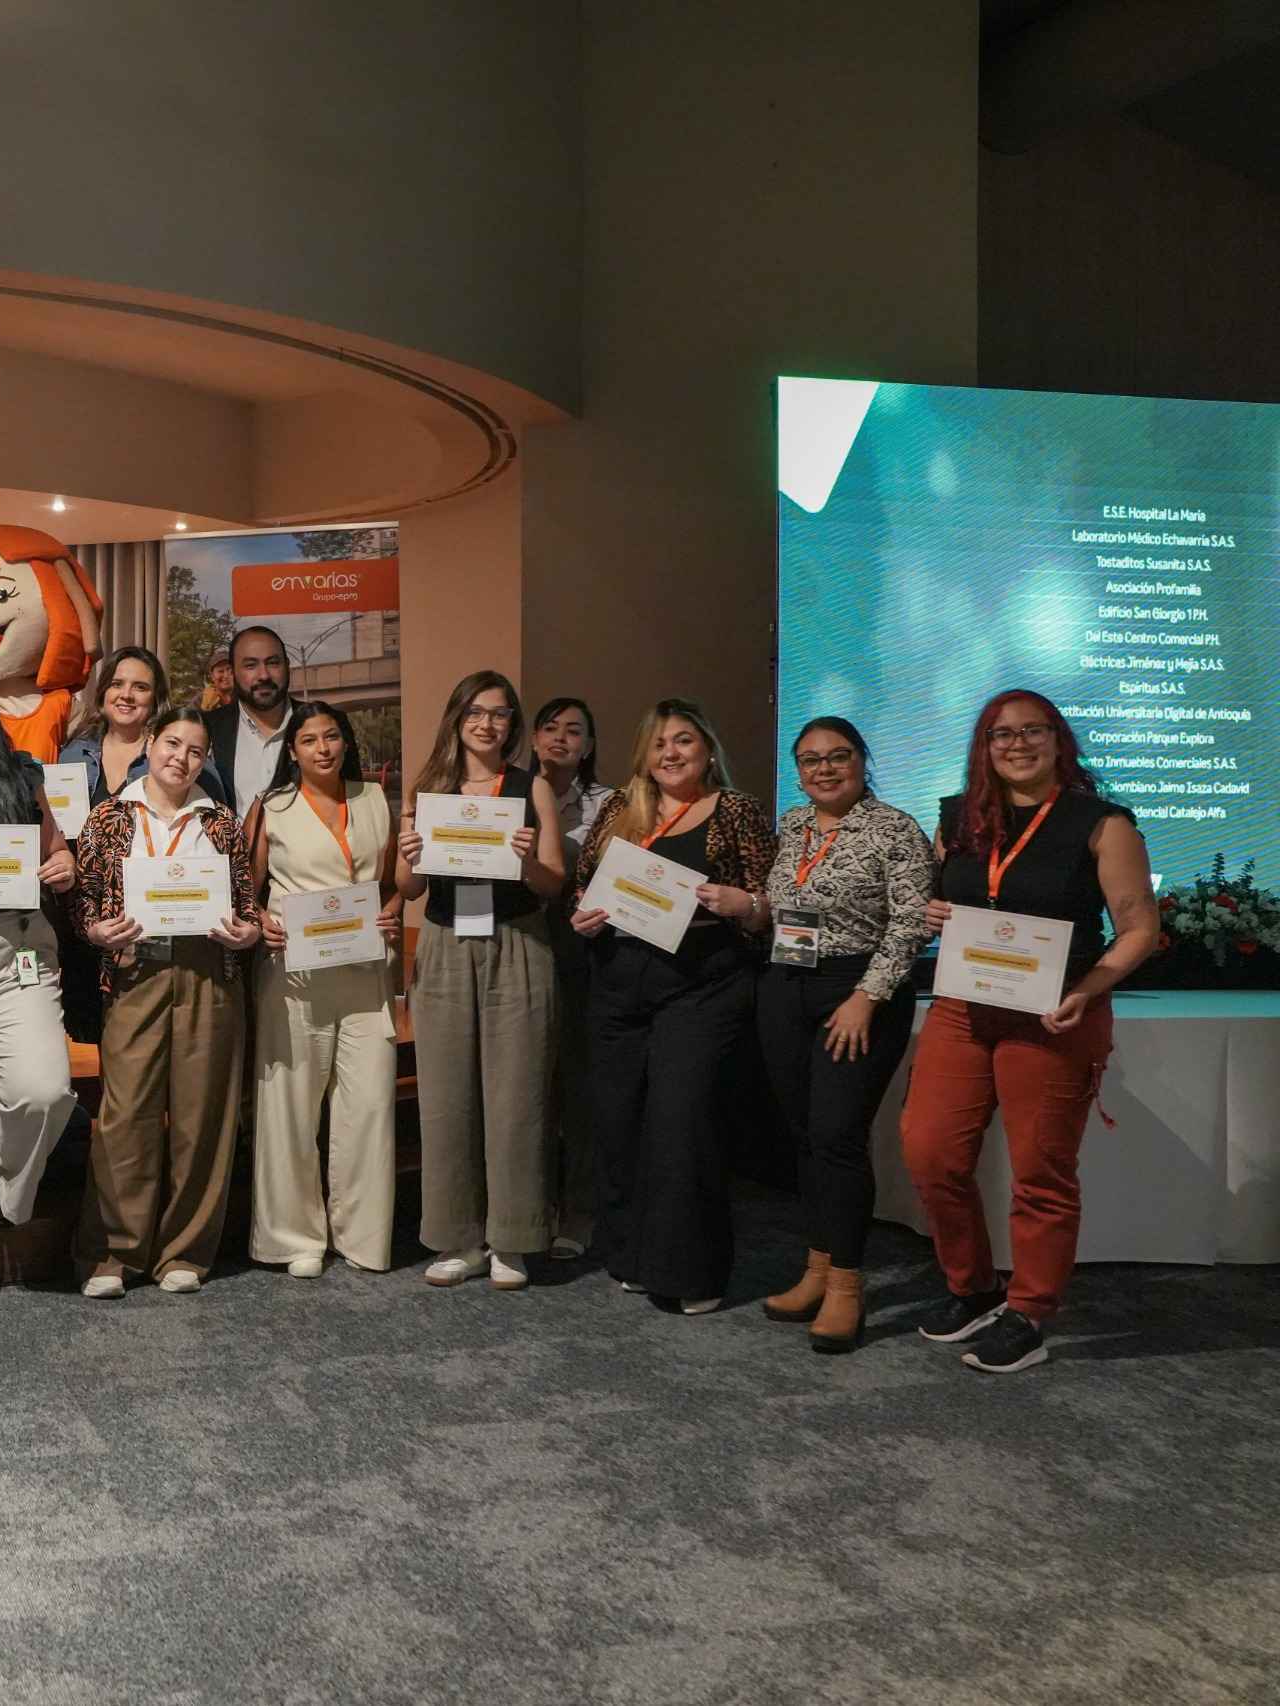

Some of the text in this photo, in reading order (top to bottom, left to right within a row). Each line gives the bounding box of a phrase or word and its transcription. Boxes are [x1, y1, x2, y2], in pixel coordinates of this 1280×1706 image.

[1128, 507, 1166, 522] Hospital
[1168, 509, 1179, 521] La
[1072, 529, 1126, 543] Laboratorio
[1128, 531, 1161, 545] Médico
[1211, 535, 1236, 547] S.A.S.
[1096, 555, 1212, 571] Tostaditos Susanita S.A.S.
[1105, 581, 1201, 596] Asociación Profamilia
[1099, 605, 1132, 619] Edificio
[1134, 607, 1151, 620] San
[1152, 607, 1186, 623] Giorgio
[1086, 630, 1100, 643] Del
[1102, 631, 1124, 644] Este
[1125, 631, 1157, 645] Centro
[1158, 632, 1203, 646] Comercial
[1080, 655, 1125, 668] Eléctricas
[1127, 656, 1166, 669] Jiménez
[1167, 660, 1174, 672] y
[1200, 659, 1225, 671] S.A.S.
[1161, 682, 1186, 695] S.A.S.
[1056, 703, 1251, 723] stitución Universitaria Digital de Antioquia
[1089, 730, 1215, 746] Corporación Parque Explora
[1105, 755, 1155, 769] Inmuebles
[1156, 757, 1212, 769] Comerciales
[1213, 757, 1237, 769] S.A.S.
[1158, 780, 1185, 794] Jaime
[1186, 781, 1212, 794] Isaza
[1213, 781, 1249, 794] Cadavid
[1132, 806, 1226, 821] idencial Catalejo Alfa
